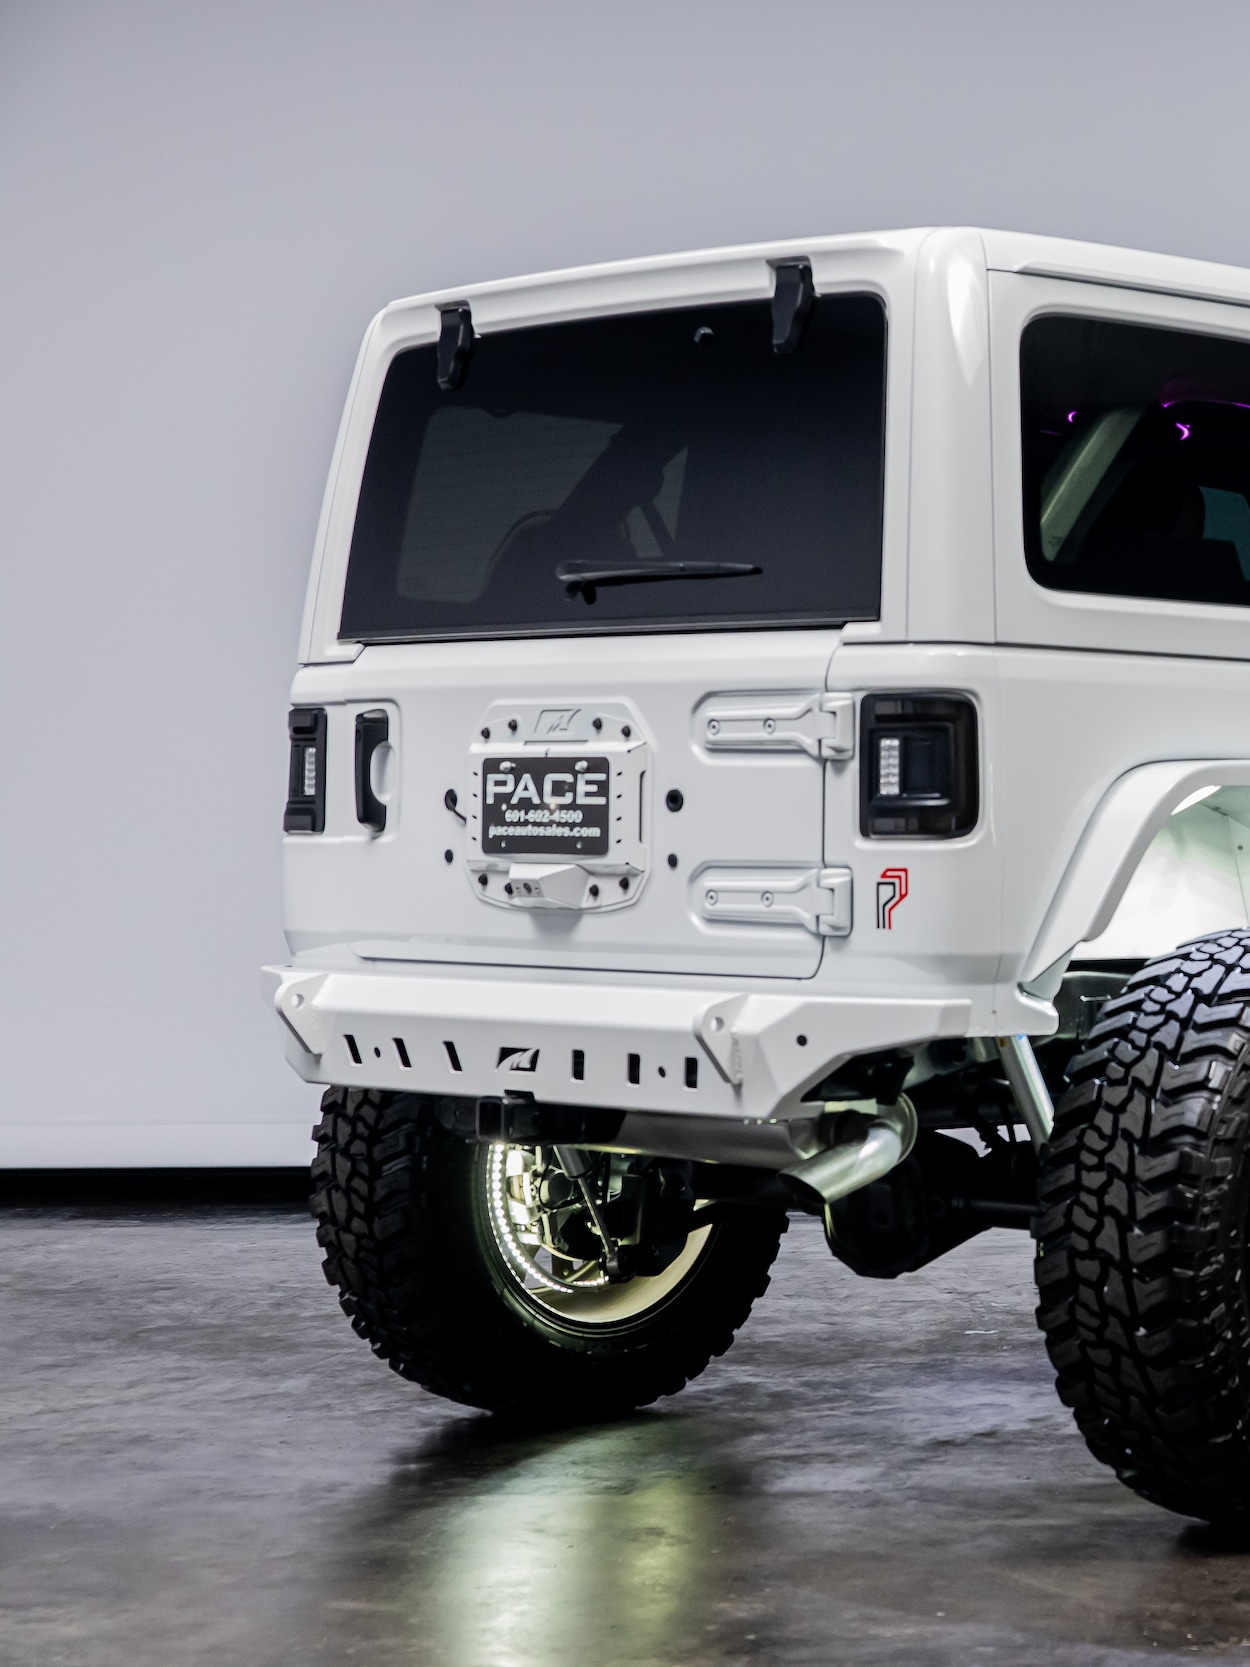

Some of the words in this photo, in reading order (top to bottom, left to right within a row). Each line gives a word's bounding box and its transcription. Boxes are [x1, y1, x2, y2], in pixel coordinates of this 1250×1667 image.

[486, 773, 607, 805] PACE
[504, 809, 583, 823] 601-602-4500
[488, 824, 601, 839] paceautosales.com
